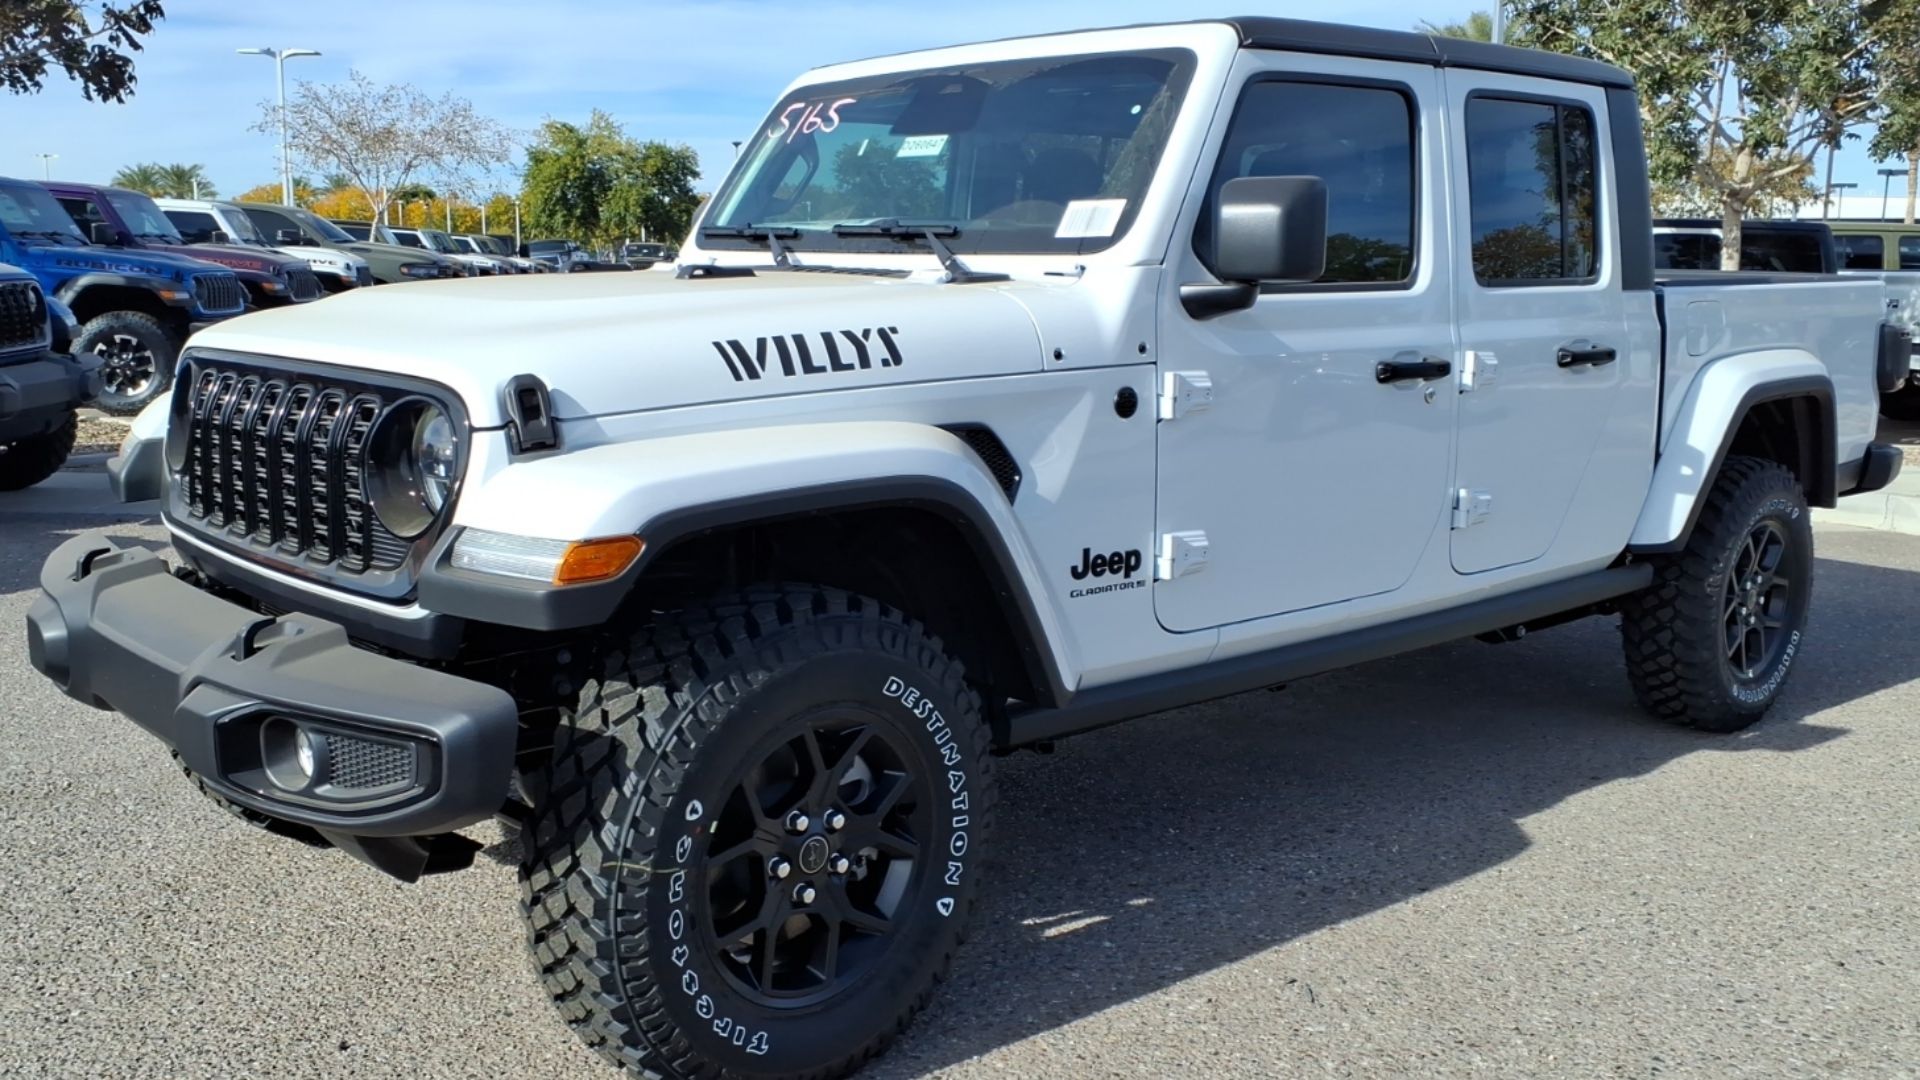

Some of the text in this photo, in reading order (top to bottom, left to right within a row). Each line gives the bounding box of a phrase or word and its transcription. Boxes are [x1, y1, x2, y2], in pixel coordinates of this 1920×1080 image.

[768, 98, 857, 144] 5165
[712, 326, 903, 381] WILLYS
[1070, 547, 1142, 580] Jeep
[1070, 581, 1135, 598] GLADIATOR
[882, 676, 969, 885] DESTINATION
[668, 835, 769, 1055] Firestone
